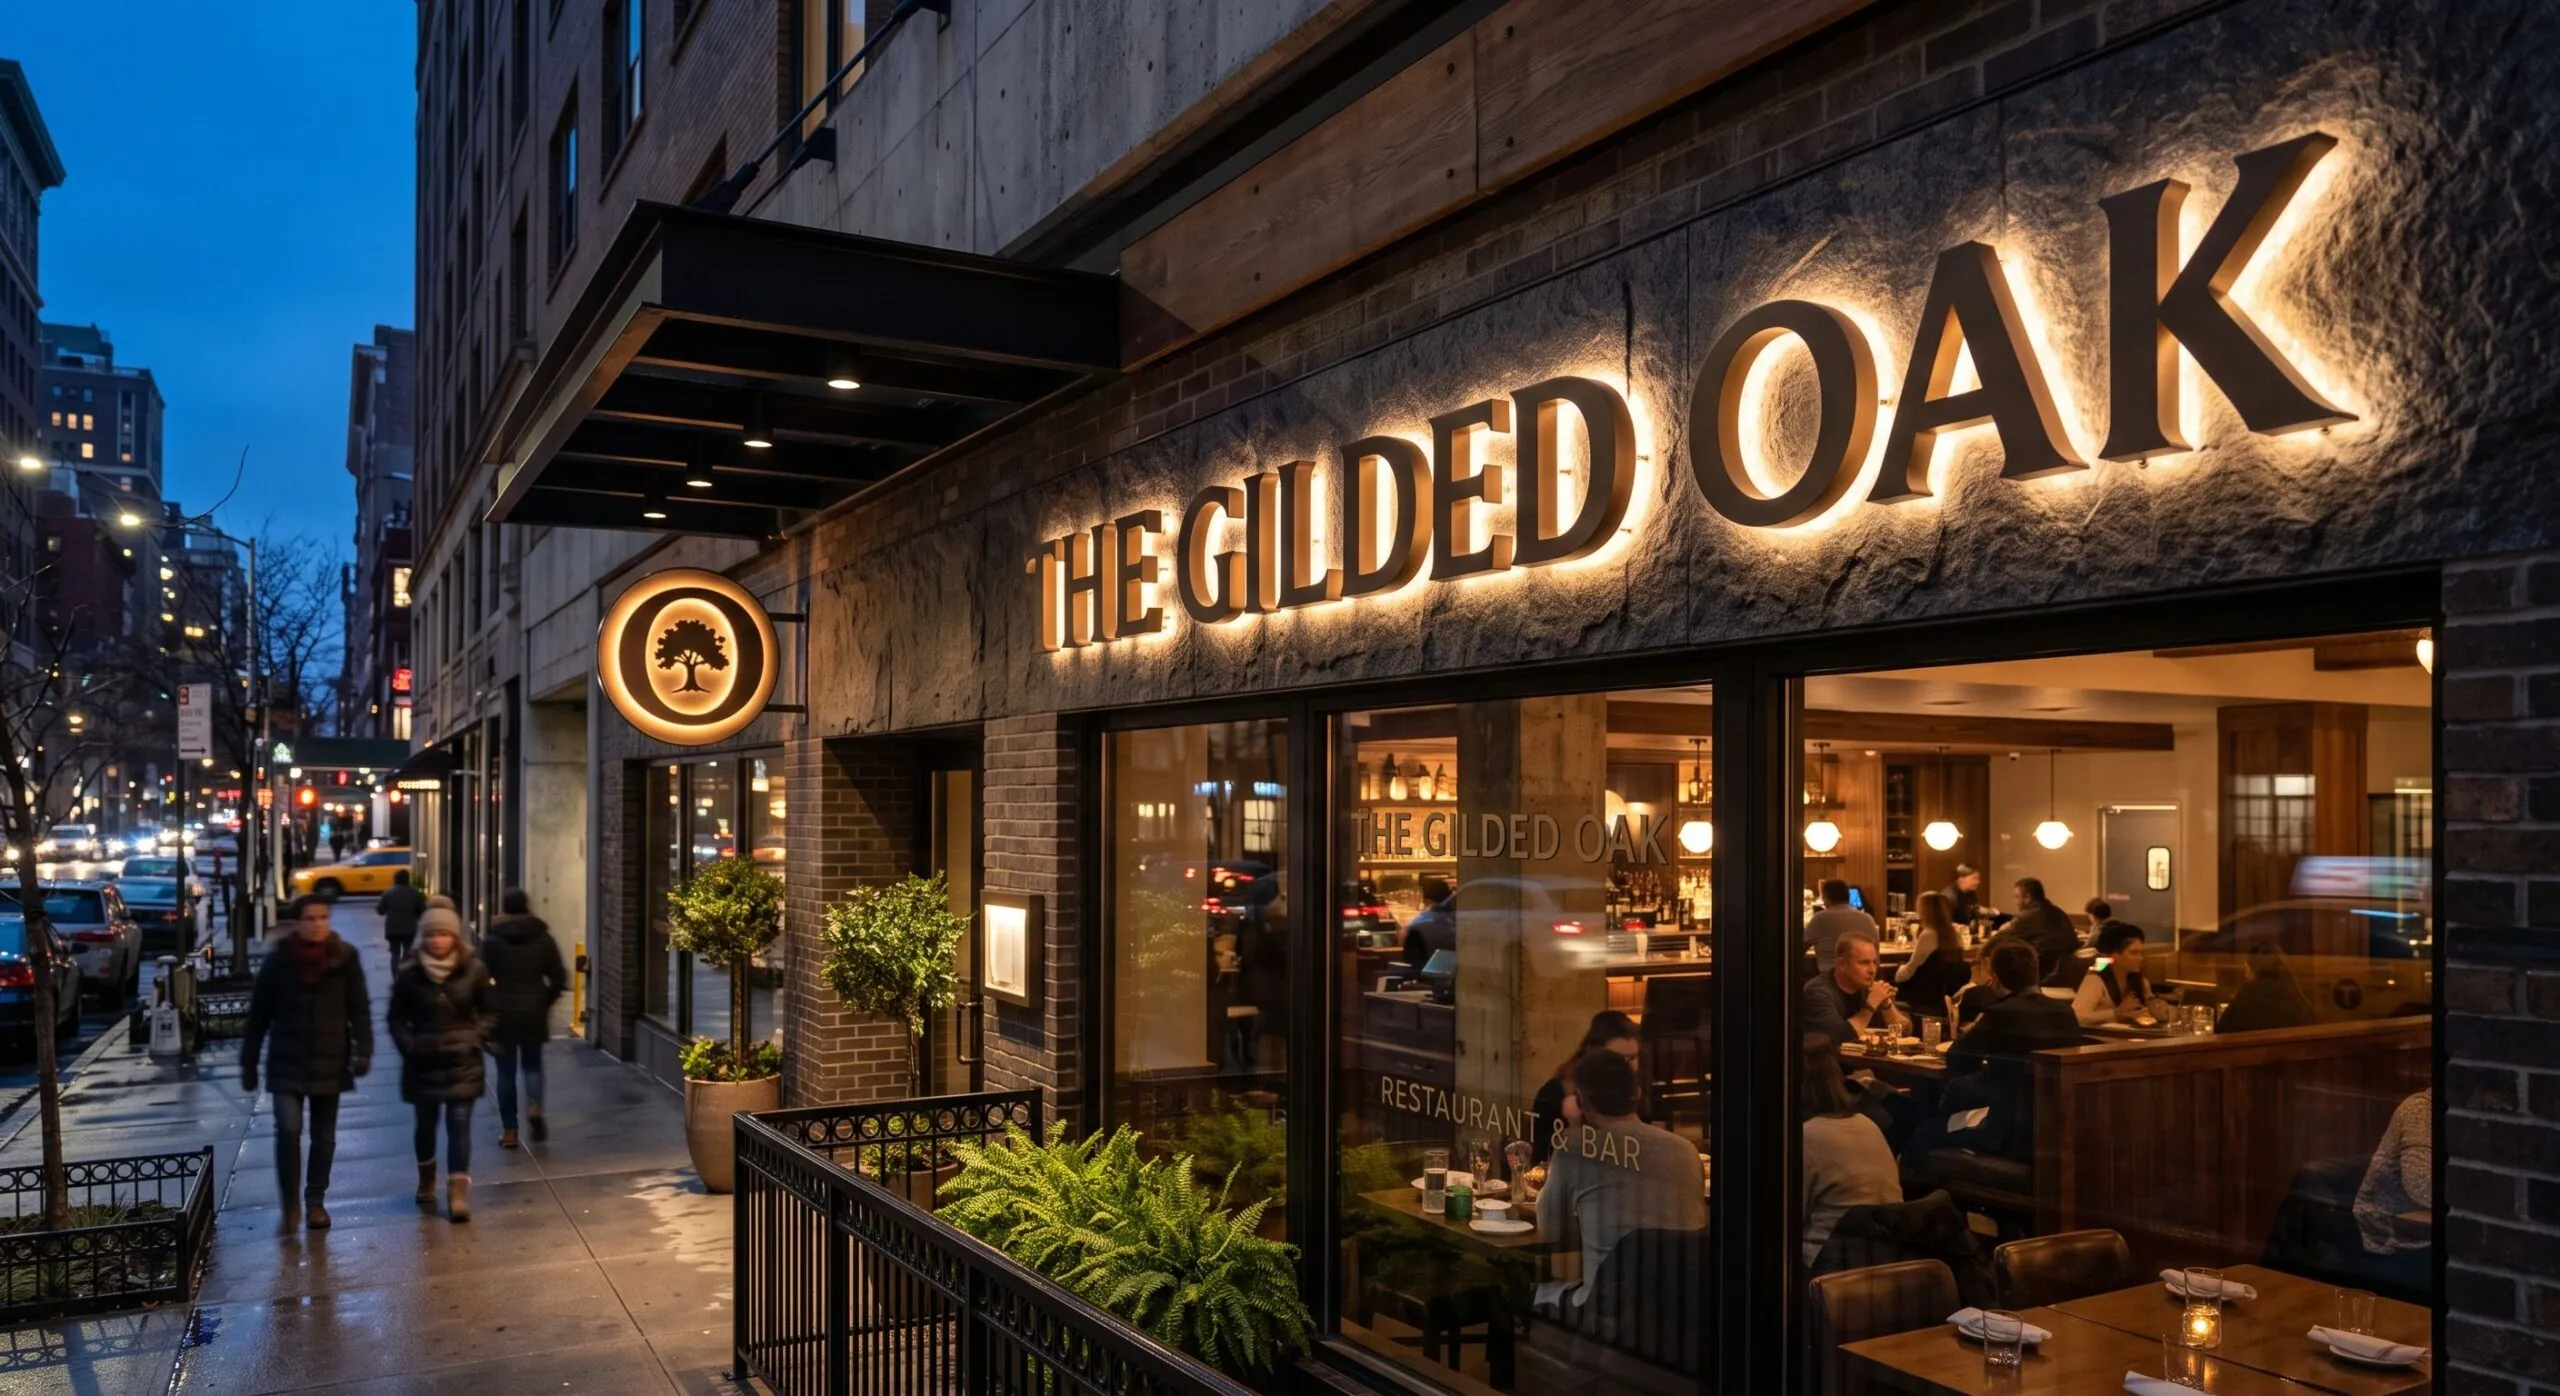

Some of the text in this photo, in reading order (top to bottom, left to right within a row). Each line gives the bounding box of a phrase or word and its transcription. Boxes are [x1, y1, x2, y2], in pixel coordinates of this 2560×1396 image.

[1025, 131, 2360, 653] THE GILDED OAK
[1350, 810, 1670, 866] THE GILDED OAK
[1381, 1075, 1641, 1172] RESTAURANT & BAR
